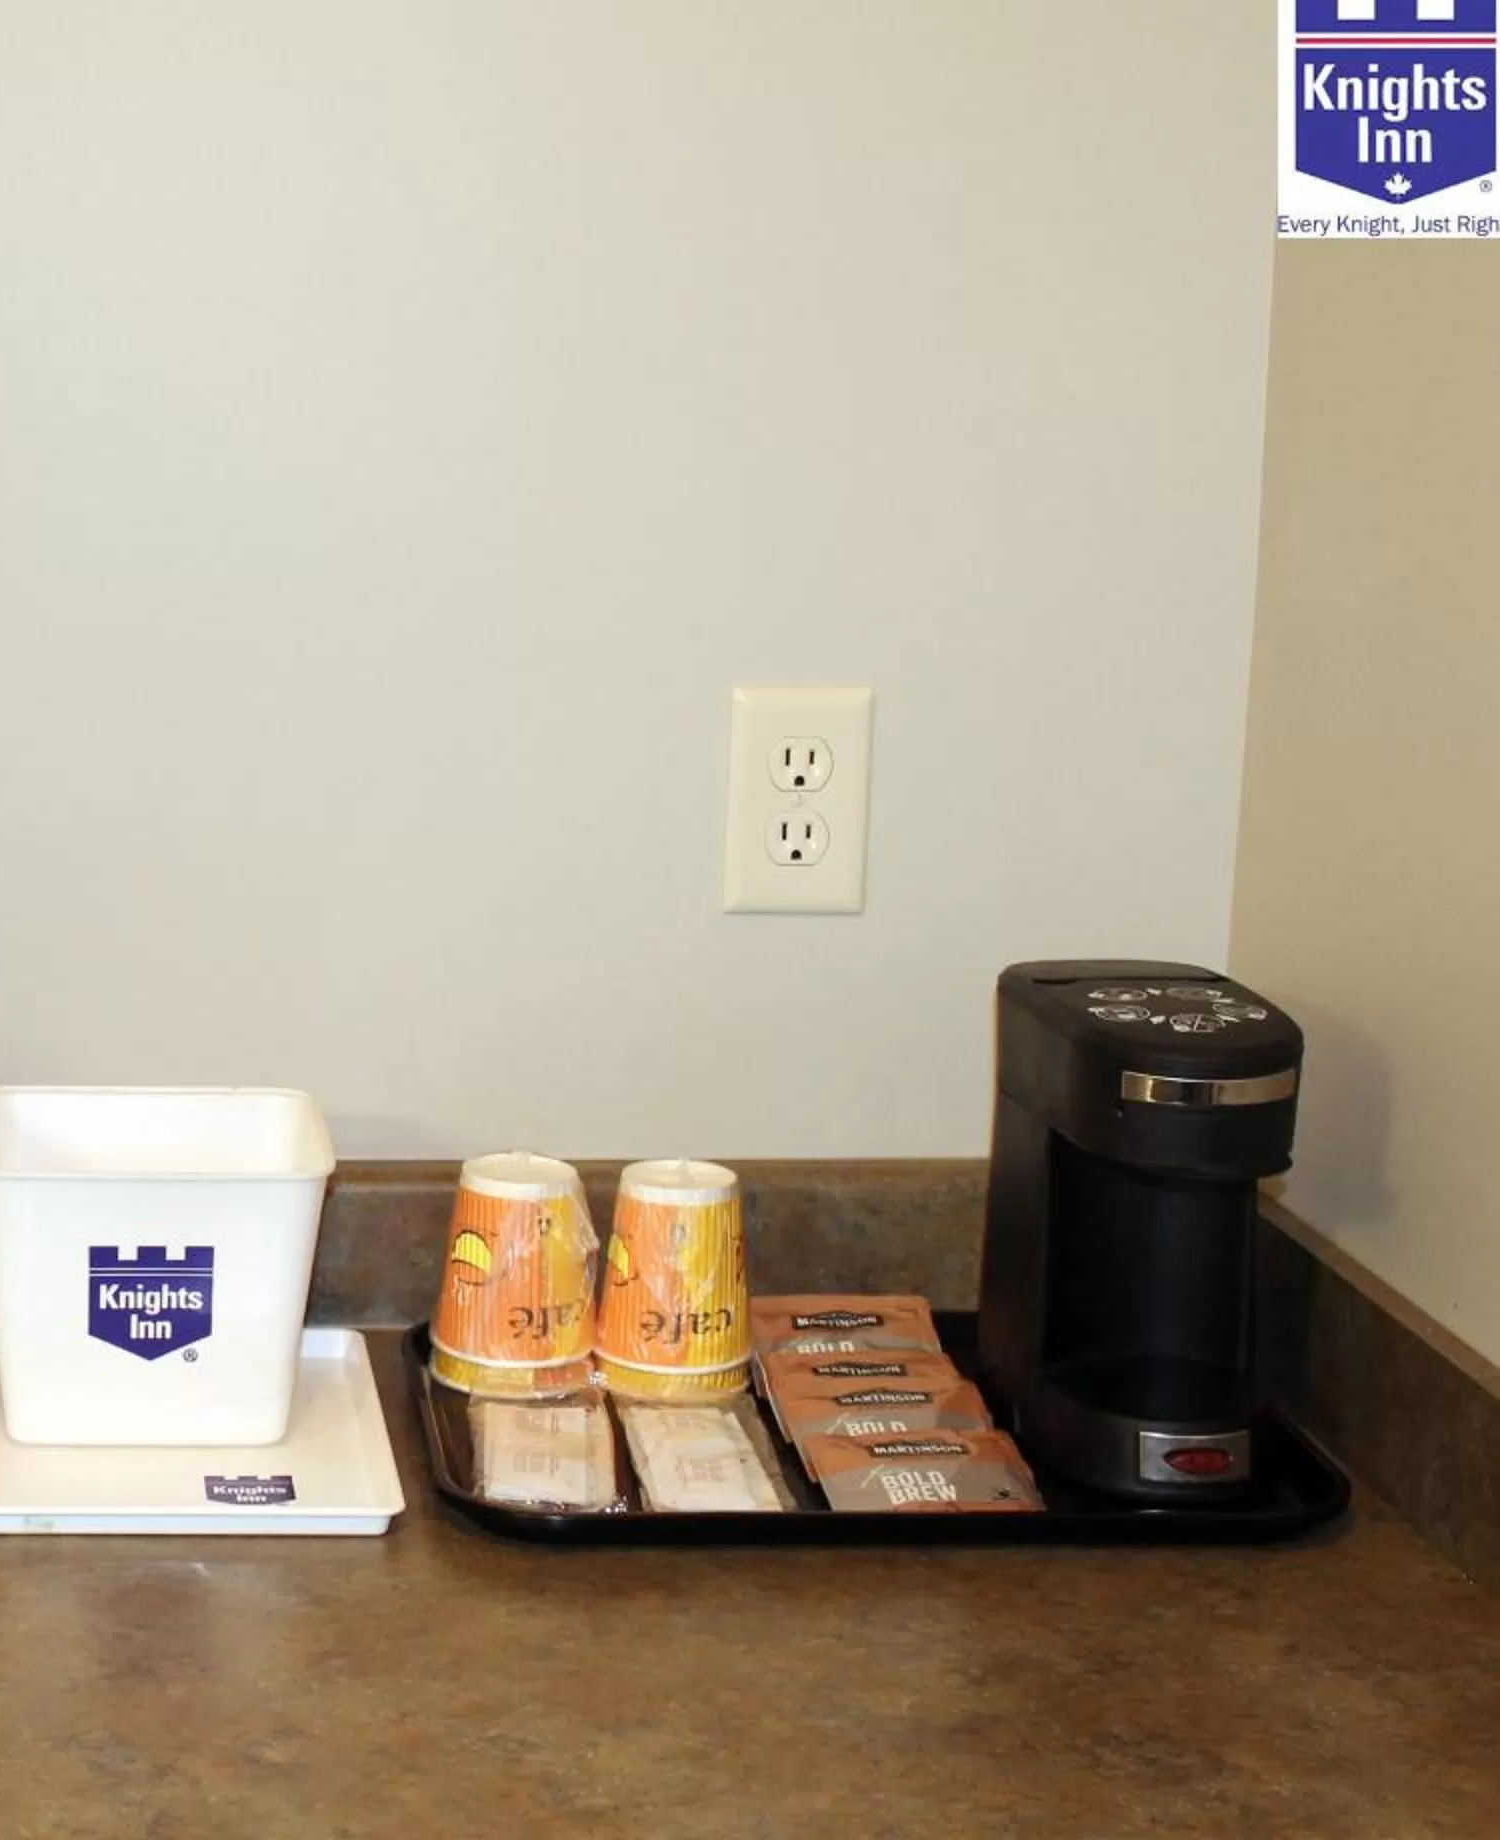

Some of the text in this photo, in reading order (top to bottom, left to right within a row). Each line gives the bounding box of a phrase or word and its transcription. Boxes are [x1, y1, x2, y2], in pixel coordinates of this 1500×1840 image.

[99, 1283, 204, 1315] Knights
[129, 1313, 172, 1340] Inn
[796, 1315, 879, 1328] MARTINSON
[873, 1444, 963, 1455] MARTINSON
[881, 1470, 947, 1491] BOLD
[887, 1484, 957, 1505] BREW
